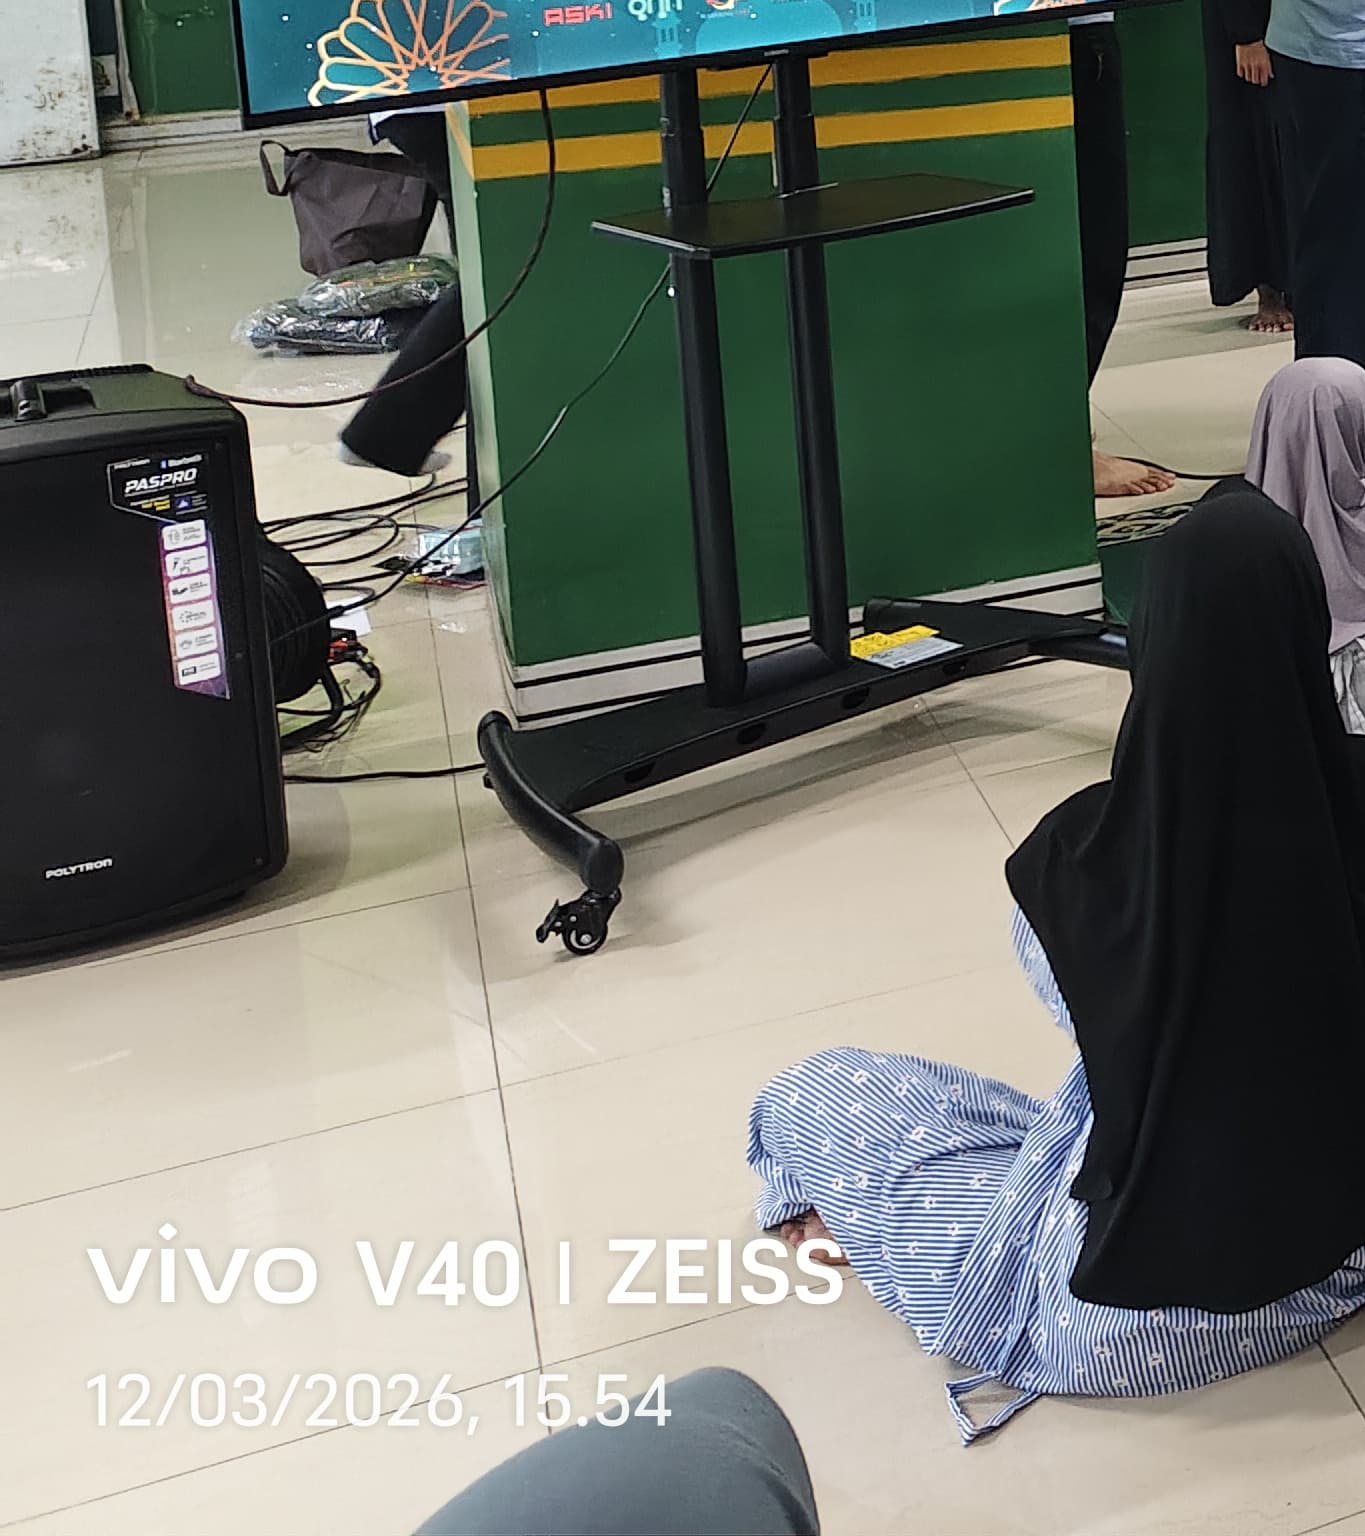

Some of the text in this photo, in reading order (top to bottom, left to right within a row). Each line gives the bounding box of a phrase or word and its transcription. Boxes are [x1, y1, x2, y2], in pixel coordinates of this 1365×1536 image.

[544, 2, 613, 26] ASKI
[124, 467, 197, 493] PASPRO
[45, 858, 113, 879] POLYTRON
